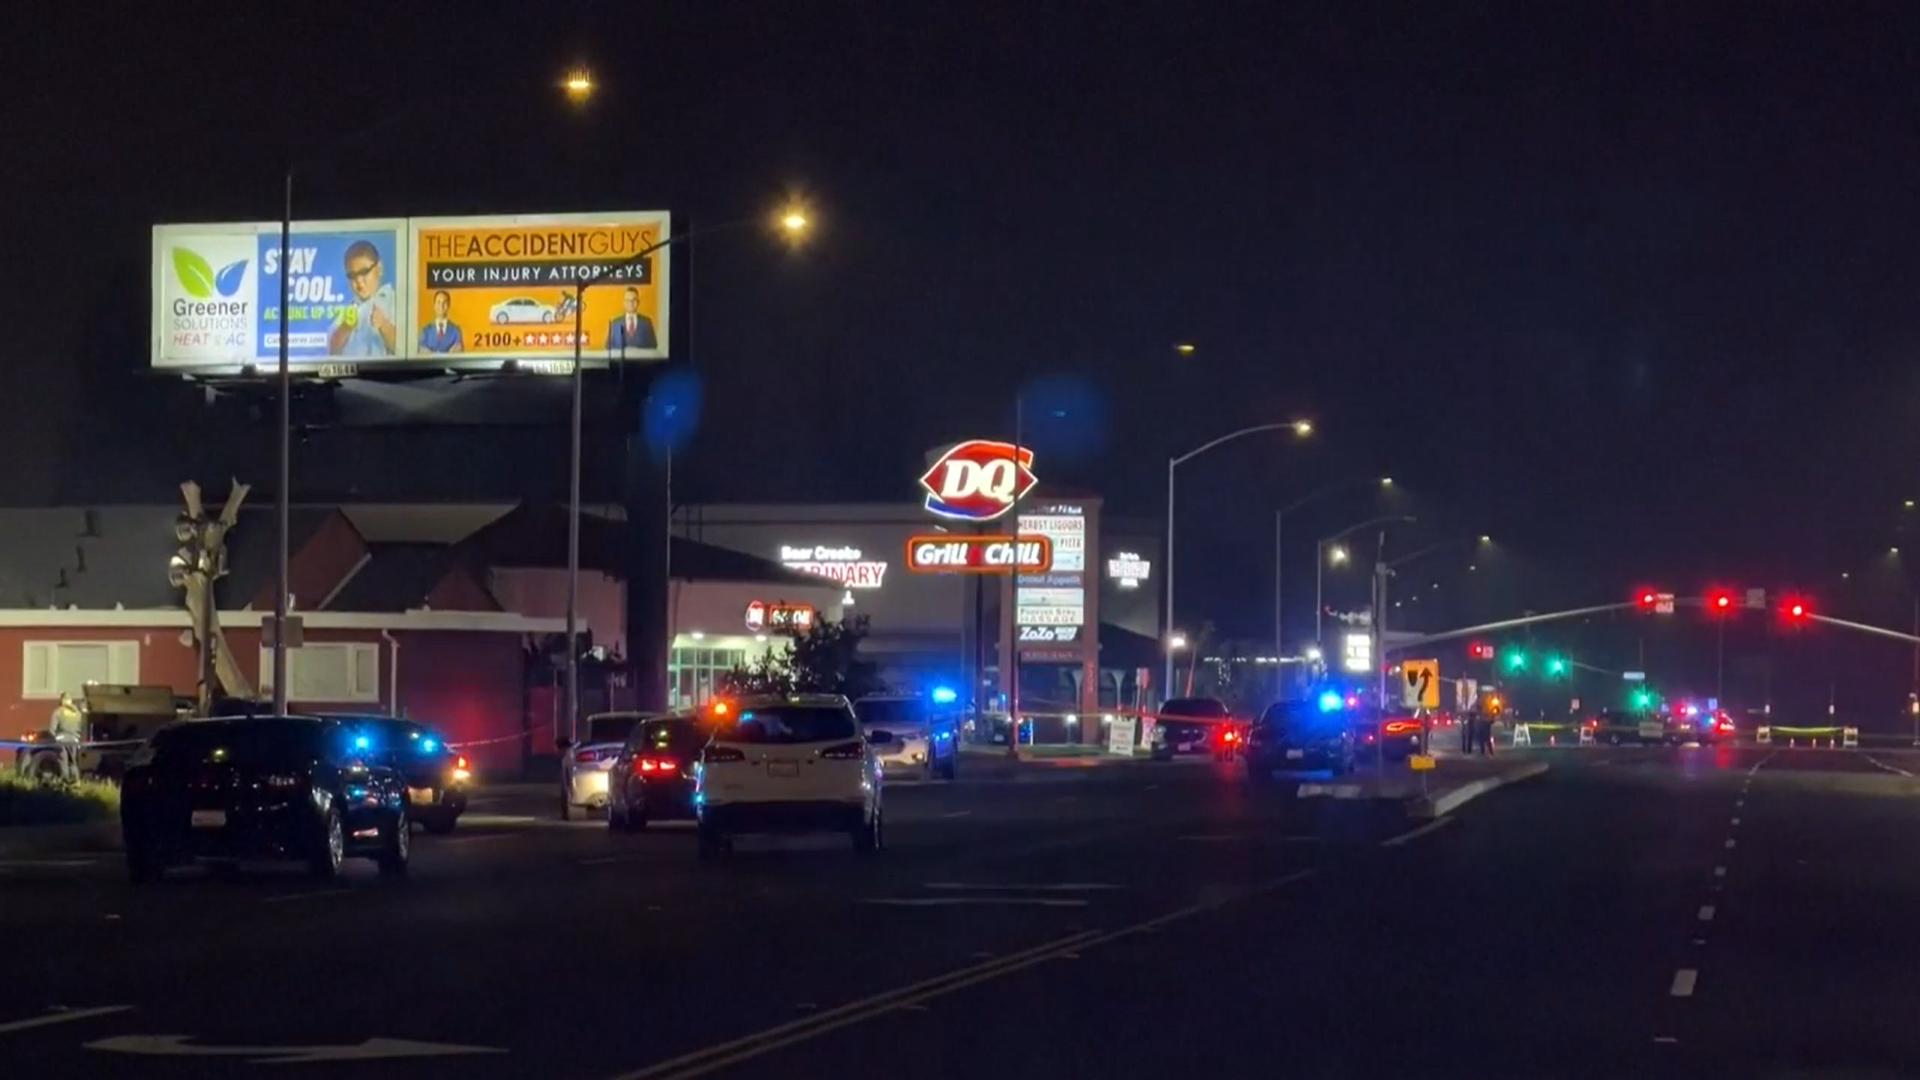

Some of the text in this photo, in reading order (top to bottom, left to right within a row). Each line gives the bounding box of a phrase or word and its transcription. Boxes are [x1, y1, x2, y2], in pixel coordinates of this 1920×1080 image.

[432, 269, 476, 282] YOUR
[484, 267, 540, 281] INJURY
[173, 298, 248, 316] Greener
[288, 305, 308, 320] UNE
[173, 317, 247, 330] SOLUTIONS
[173, 333, 208, 346] HEAT
[227, 333, 246, 346] AC
[474, 332, 521, 347] 2100+
[941, 459, 1016, 504] DQ
[916, 542, 968, 564] Grill
[985, 542, 1040, 564] Chill
